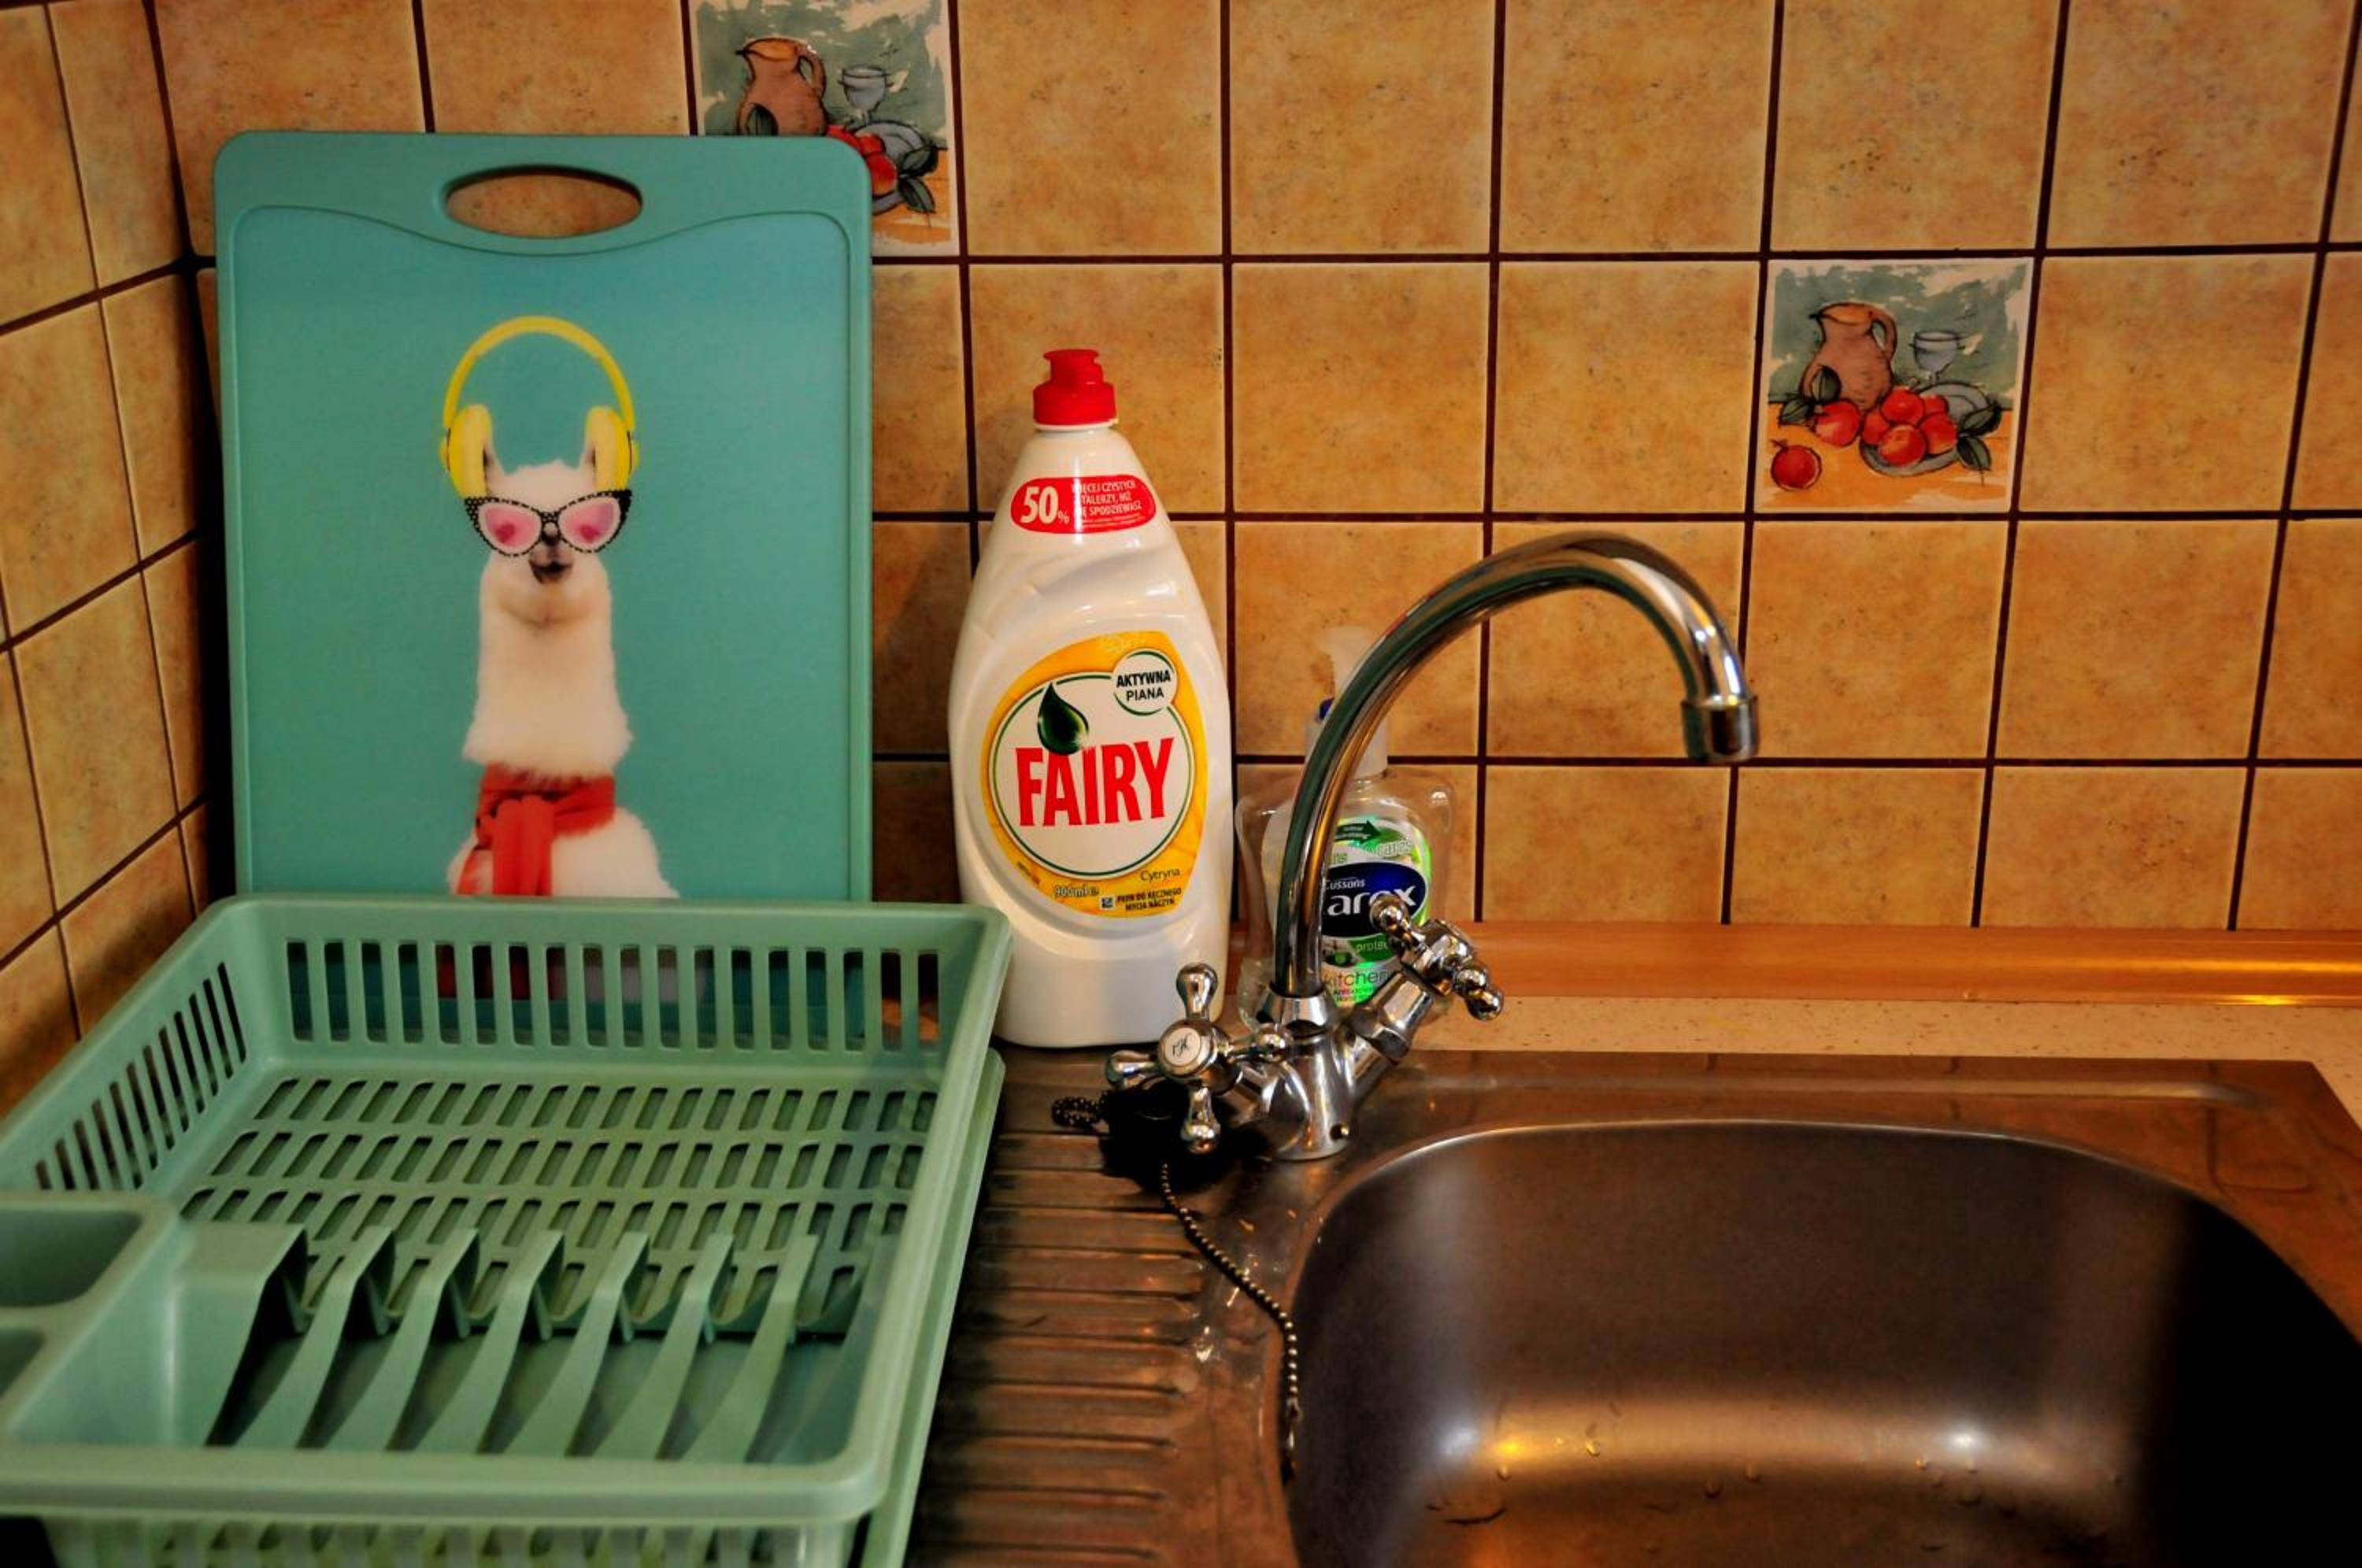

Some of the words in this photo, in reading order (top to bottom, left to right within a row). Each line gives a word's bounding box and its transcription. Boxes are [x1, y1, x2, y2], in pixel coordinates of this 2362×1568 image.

[1116, 669, 1172, 688] AKTYWNA
[1126, 686, 1164, 701] PIANA
[1016, 736, 1175, 827] FAIRY
[1140, 868, 1181, 882] Cytryna
[1327, 886, 1416, 916] arx
[1356, 941, 1389, 953] protec
